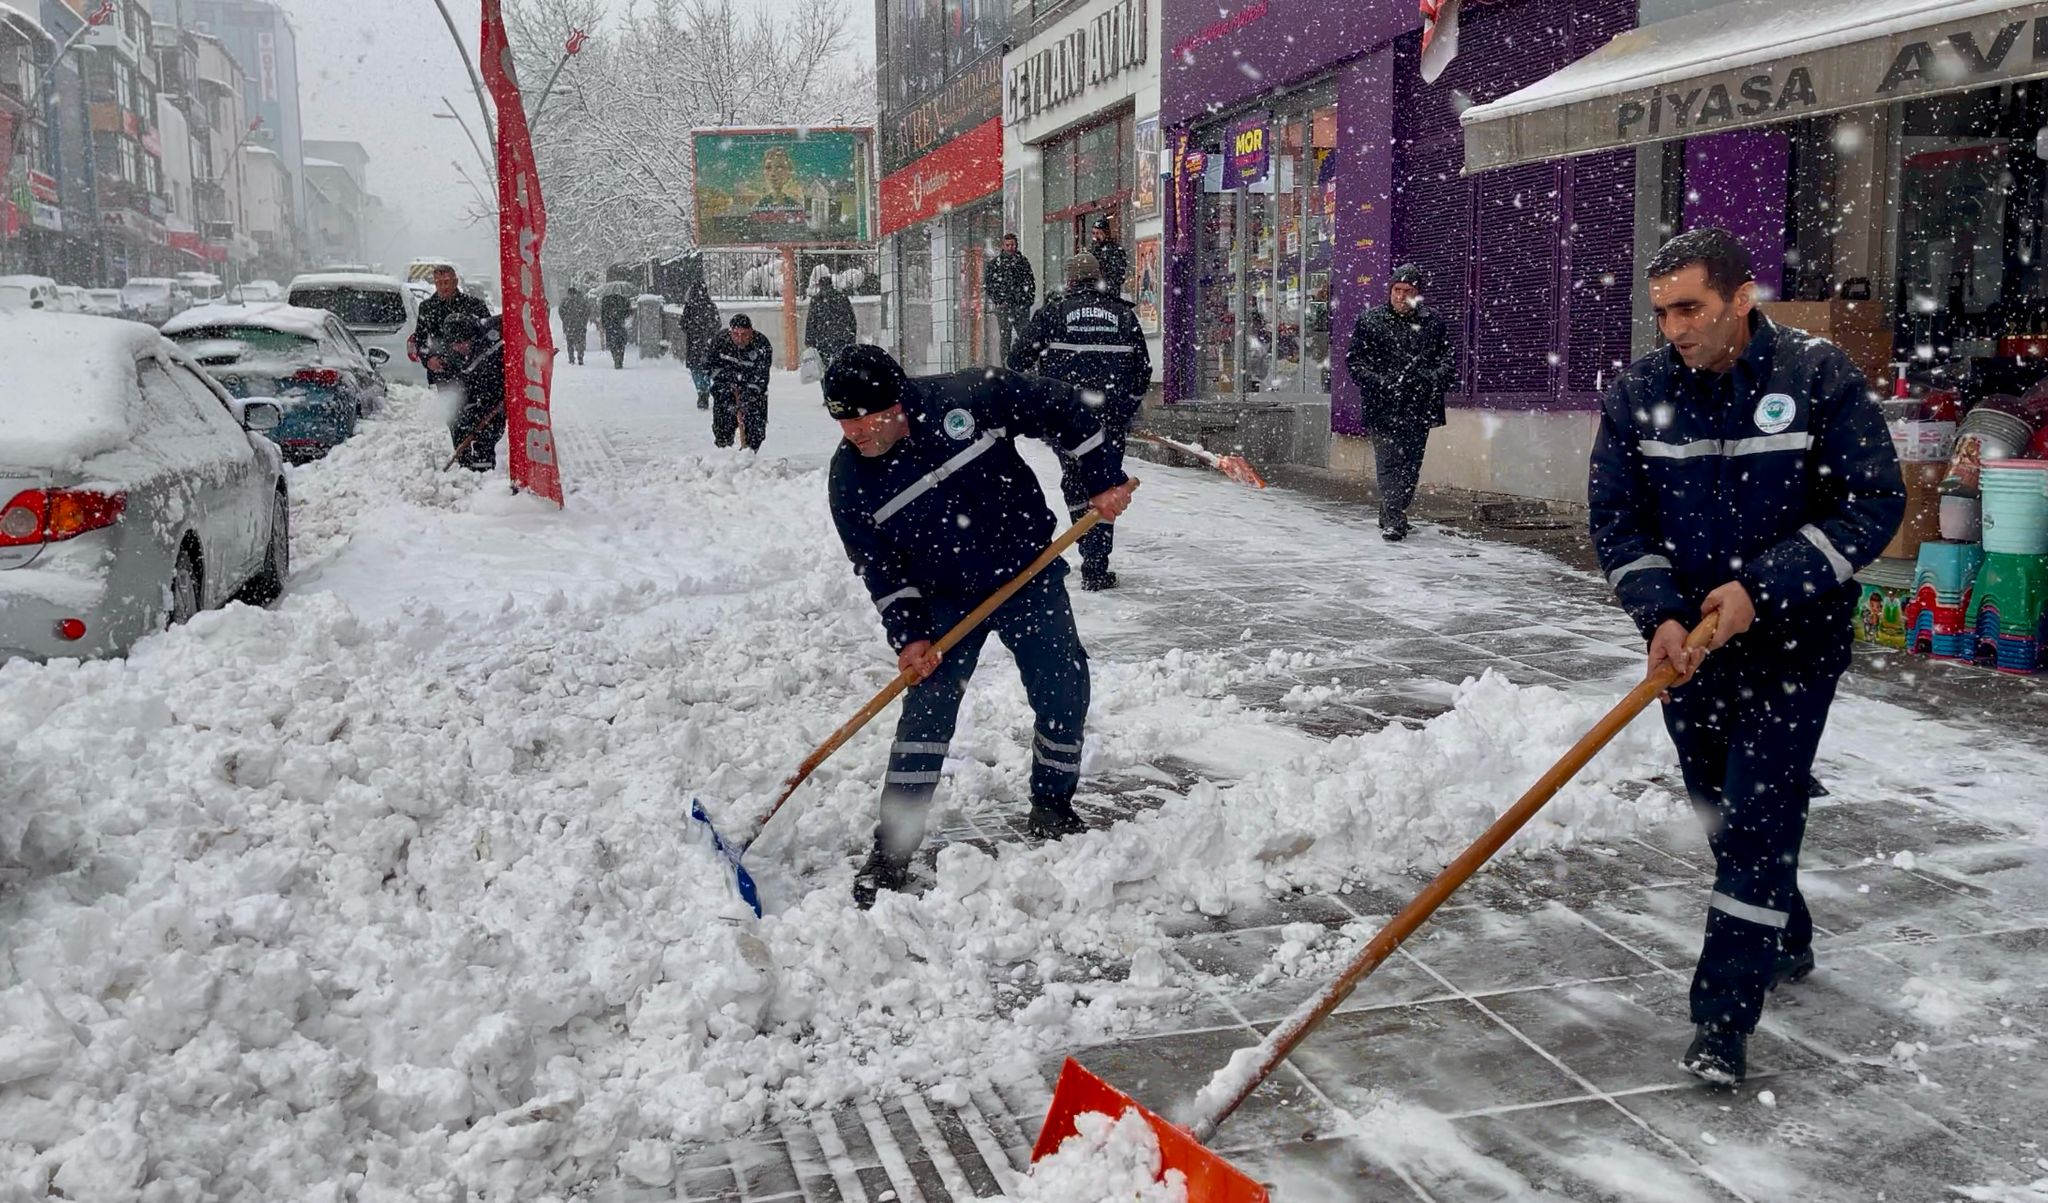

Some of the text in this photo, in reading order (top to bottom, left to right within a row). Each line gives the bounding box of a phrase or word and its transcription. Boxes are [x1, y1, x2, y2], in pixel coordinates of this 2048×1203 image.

[1006, 28, 1086, 126] CEYLAN
[1087, 0, 1148, 87] AVM
[1617, 16, 2048, 139] PİYASA AV
[1235, 128, 1263, 157] MOR
